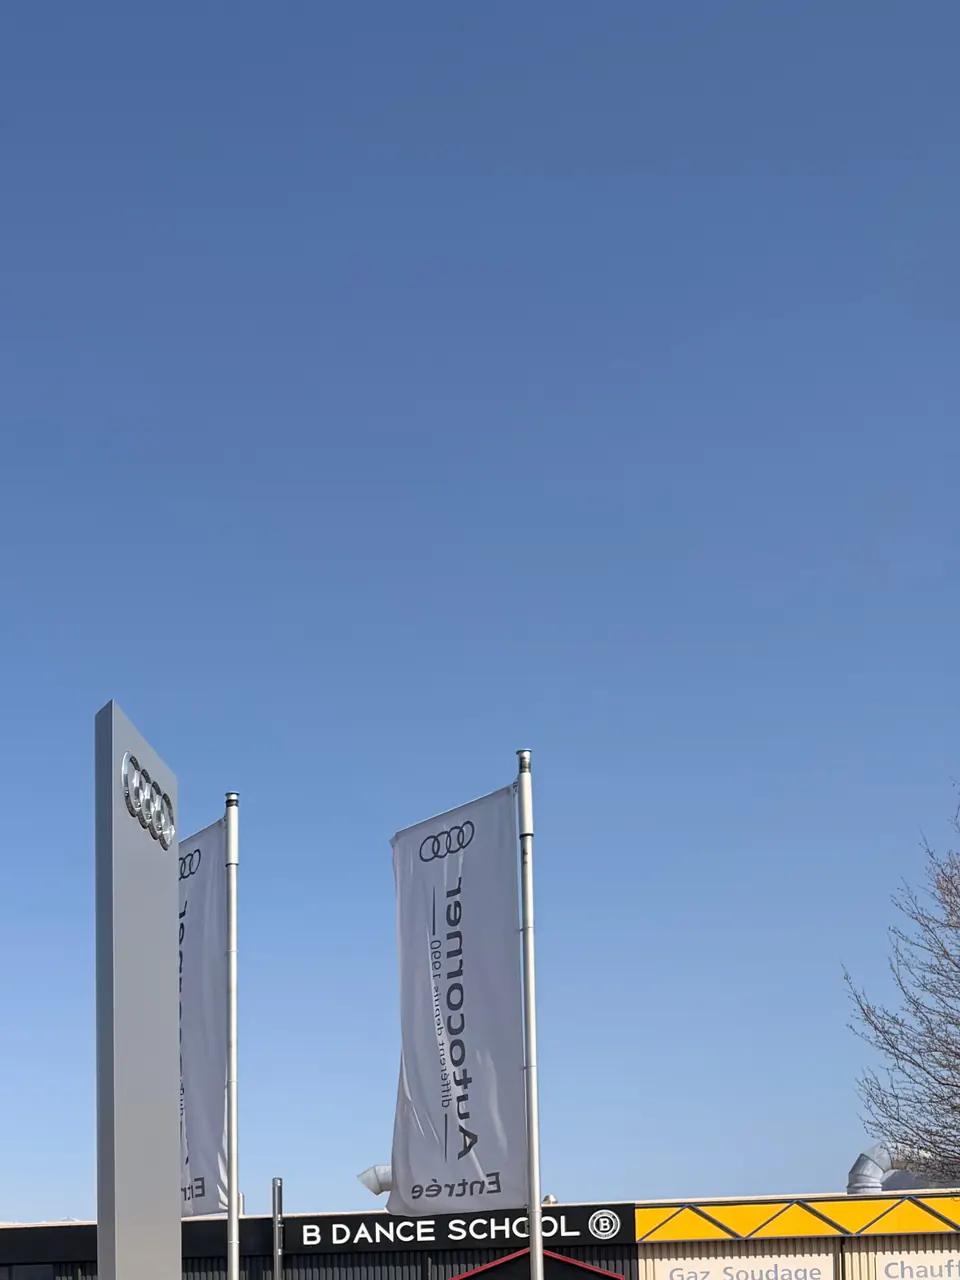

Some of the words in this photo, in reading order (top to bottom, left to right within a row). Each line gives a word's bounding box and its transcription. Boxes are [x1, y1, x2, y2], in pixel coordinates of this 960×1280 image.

[302, 1224, 321, 1246] B
[331, 1220, 436, 1245] DANCE
[447, 1215, 581, 1241] SCHOOL
